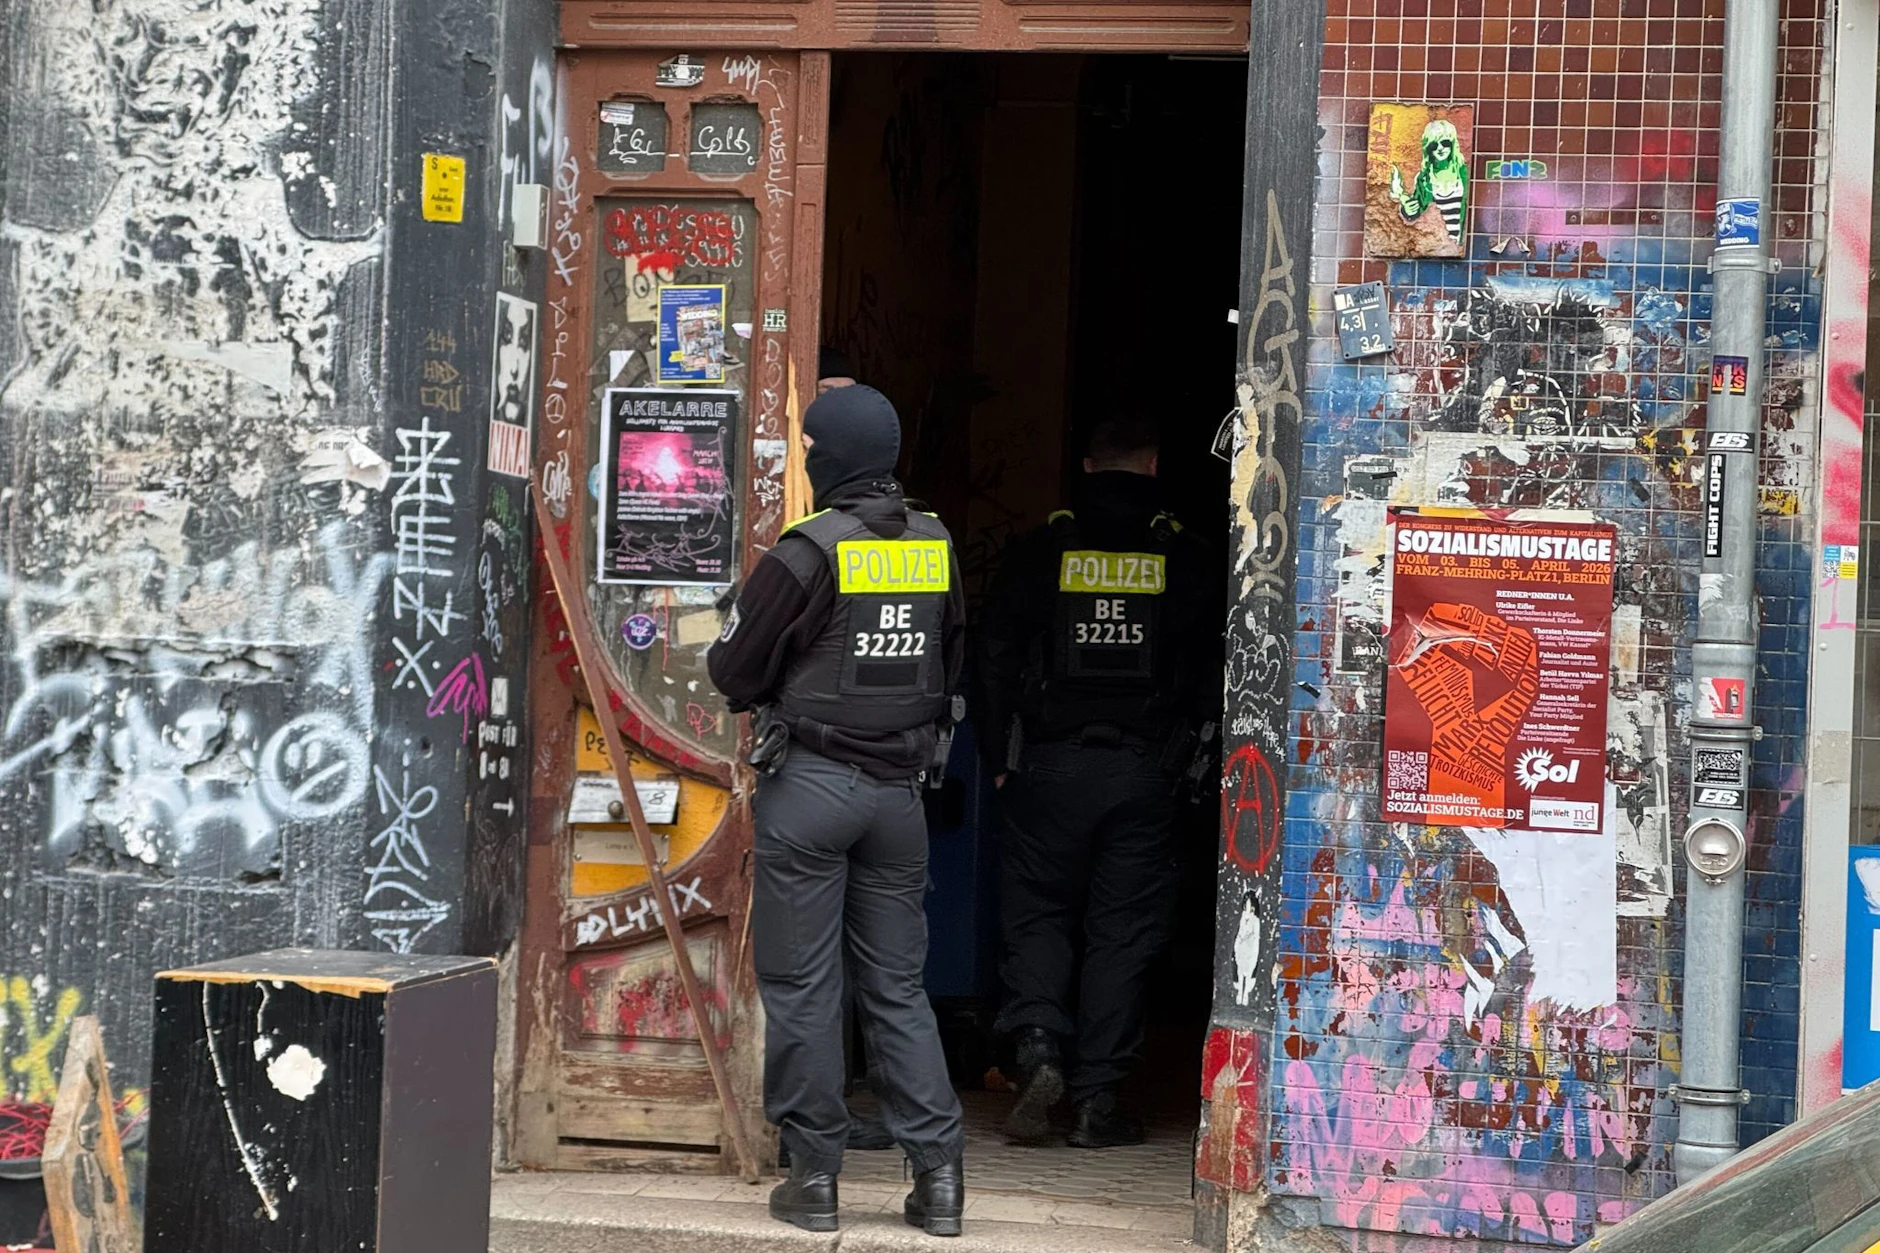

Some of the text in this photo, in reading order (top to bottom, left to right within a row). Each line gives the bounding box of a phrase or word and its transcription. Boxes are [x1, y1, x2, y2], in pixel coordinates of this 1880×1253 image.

[763, 314, 787, 328] HR
[619, 400, 728, 418] AKELARRE
[489, 422, 530, 475] NINA
[1706, 454, 1722, 555] FIGHT COPS
[1398, 530, 1611, 561] SOZIALISMUSTAGE
[845, 548, 947, 585] POLIZEI
[1065, 556, 1161, 589] POLIZEI
[1397, 554, 1610, 573] VOM 03. BIS 05. APRIL 2026
[1563, 573, 1610, 585] BERLIN
[879, 604, 912, 630] BE
[1095, 600, 1126, 620] BE
[854, 633, 925, 657] 32222
[1076, 624, 1144, 644] 32215
[1500, 631, 1534, 681] ANTIFA
[1431, 656, 1474, 719] FEMINISMUS
[1468, 663, 1538, 777] REVOLUTION
[1432, 714, 1489, 763] MARX
[1431, 754, 1496, 792] TROTZKISMUS
[1458, 753, 1502, 784] GESCHICHTE
[1530, 760, 1580, 783] Sol
[1386, 790, 1480, 805] Jetzt anmelden:
[1386, 802, 1524, 820] SOZIALISMUSTAGE.DE
[1574, 806, 1595, 820] nd
